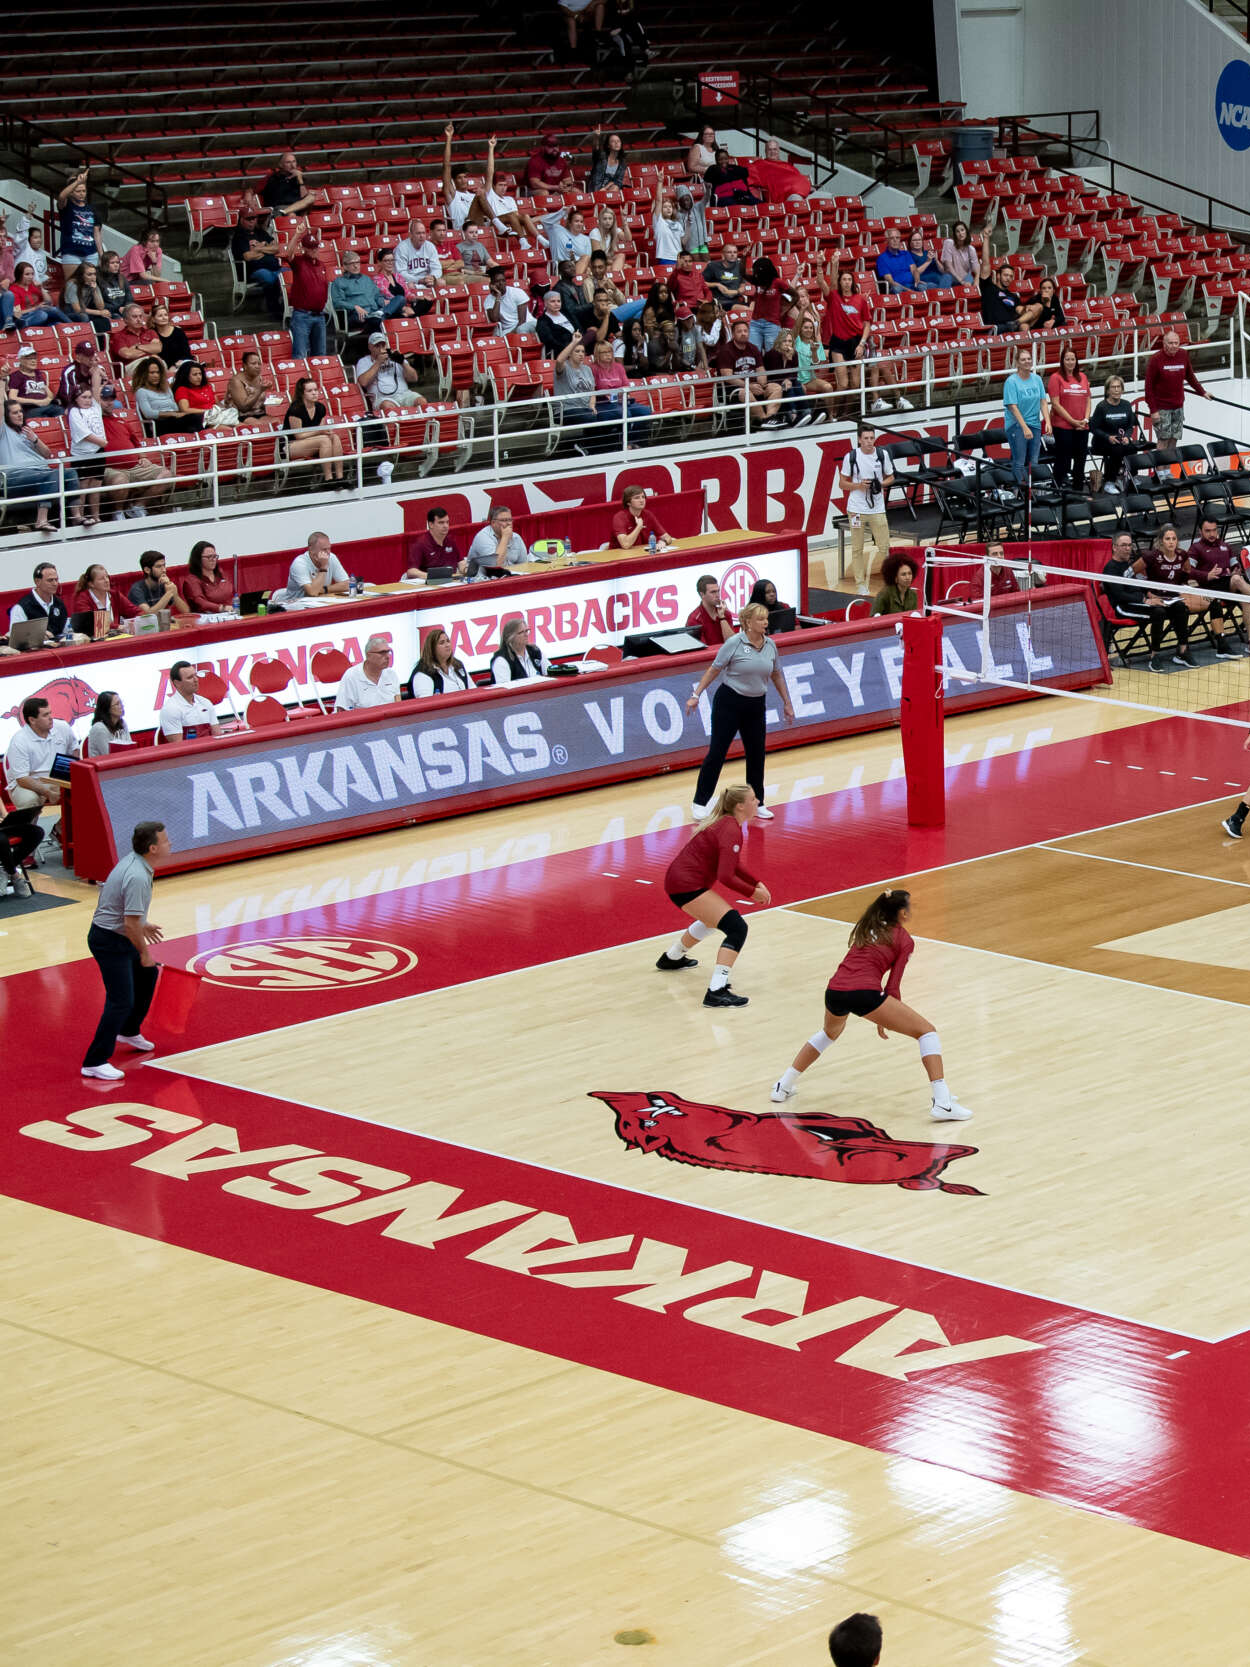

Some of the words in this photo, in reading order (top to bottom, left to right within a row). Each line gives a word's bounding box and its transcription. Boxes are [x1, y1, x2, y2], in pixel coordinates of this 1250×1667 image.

[153, 631, 394, 711] AKNAS
[584, 622, 1054, 756] VOEYALL
[204, 940, 399, 987] SEC
[18, 1102, 1044, 1381] ARKANSAS
